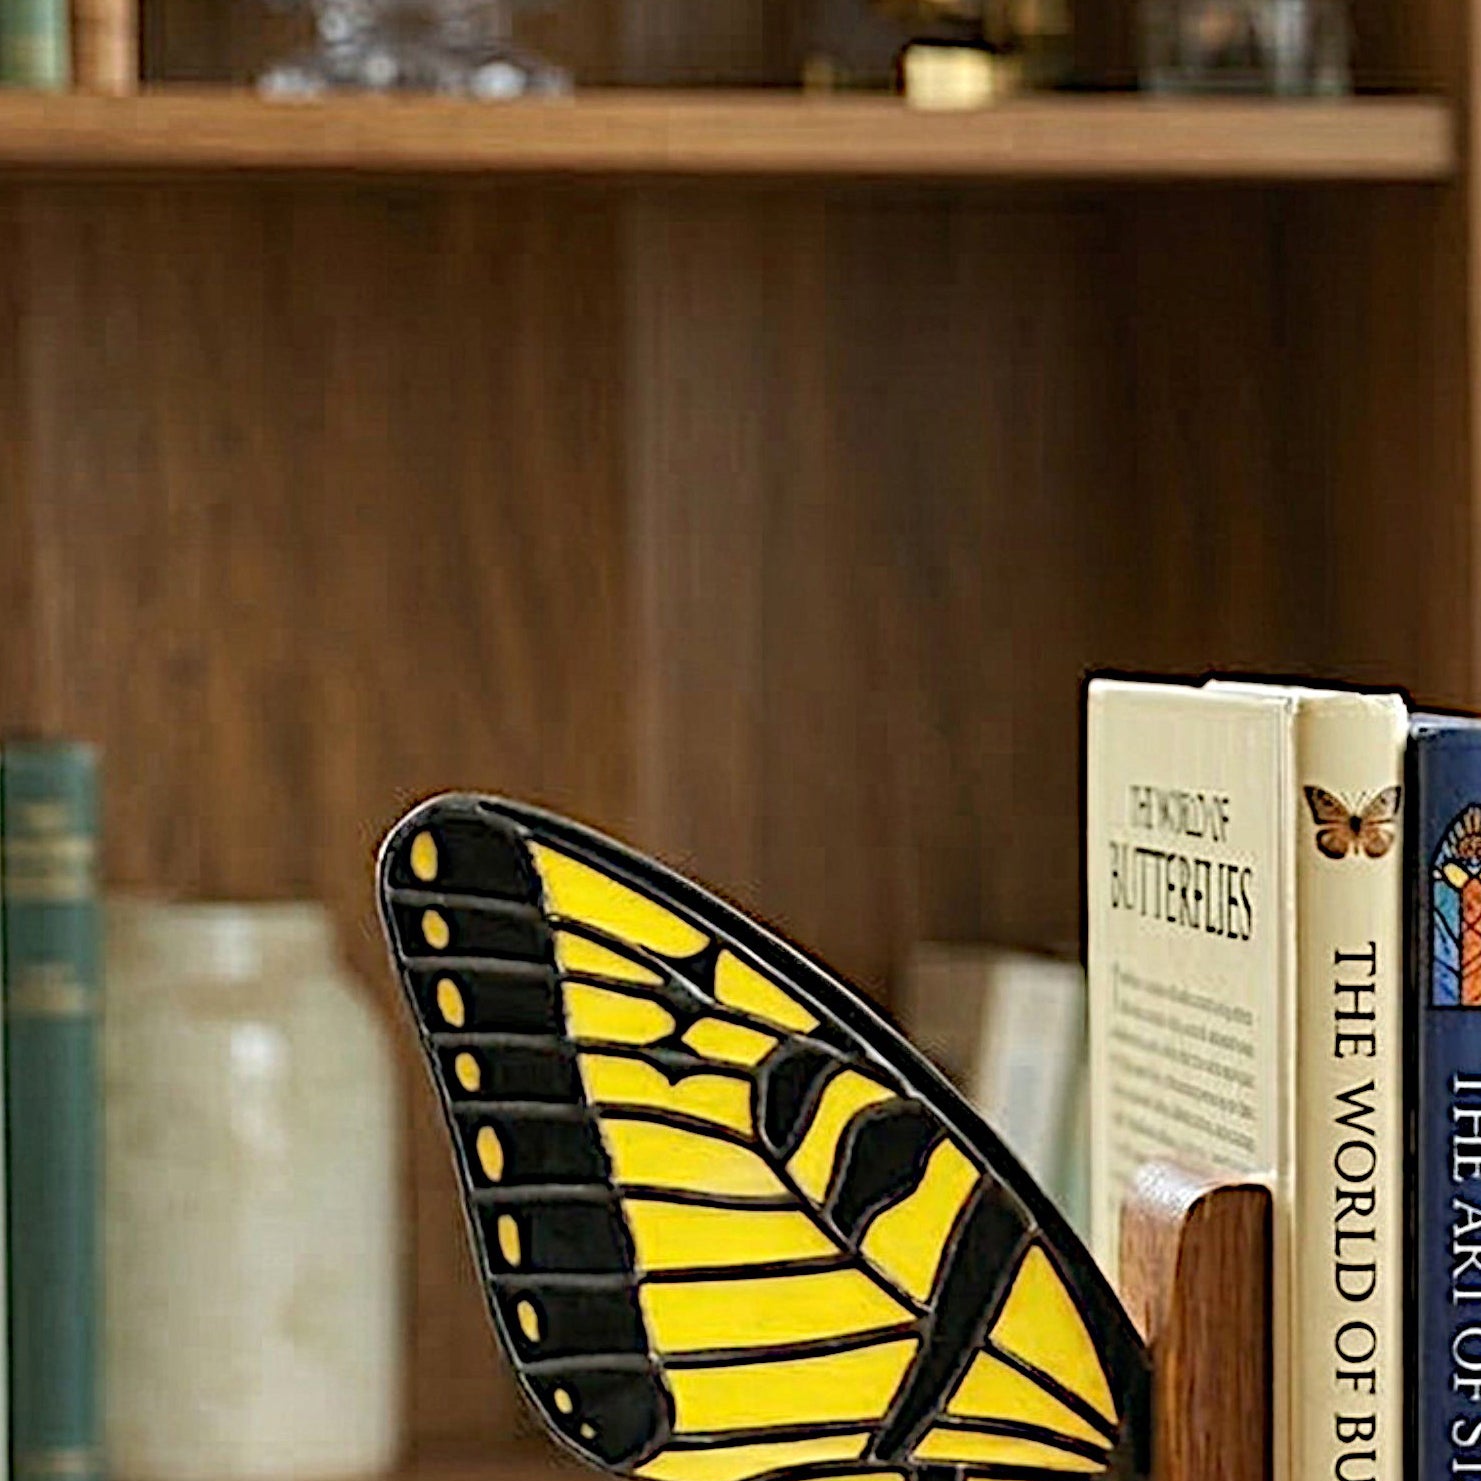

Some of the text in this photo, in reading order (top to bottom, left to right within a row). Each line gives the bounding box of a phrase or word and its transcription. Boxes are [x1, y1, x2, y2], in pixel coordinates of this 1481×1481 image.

[1109, 841, 1252, 941] BUTTERFLIES
[1334, 941, 1377, 1059] THE
[1334, 1081, 1377, 1302] WORLD
[1334, 1321, 1377, 1395] OF
